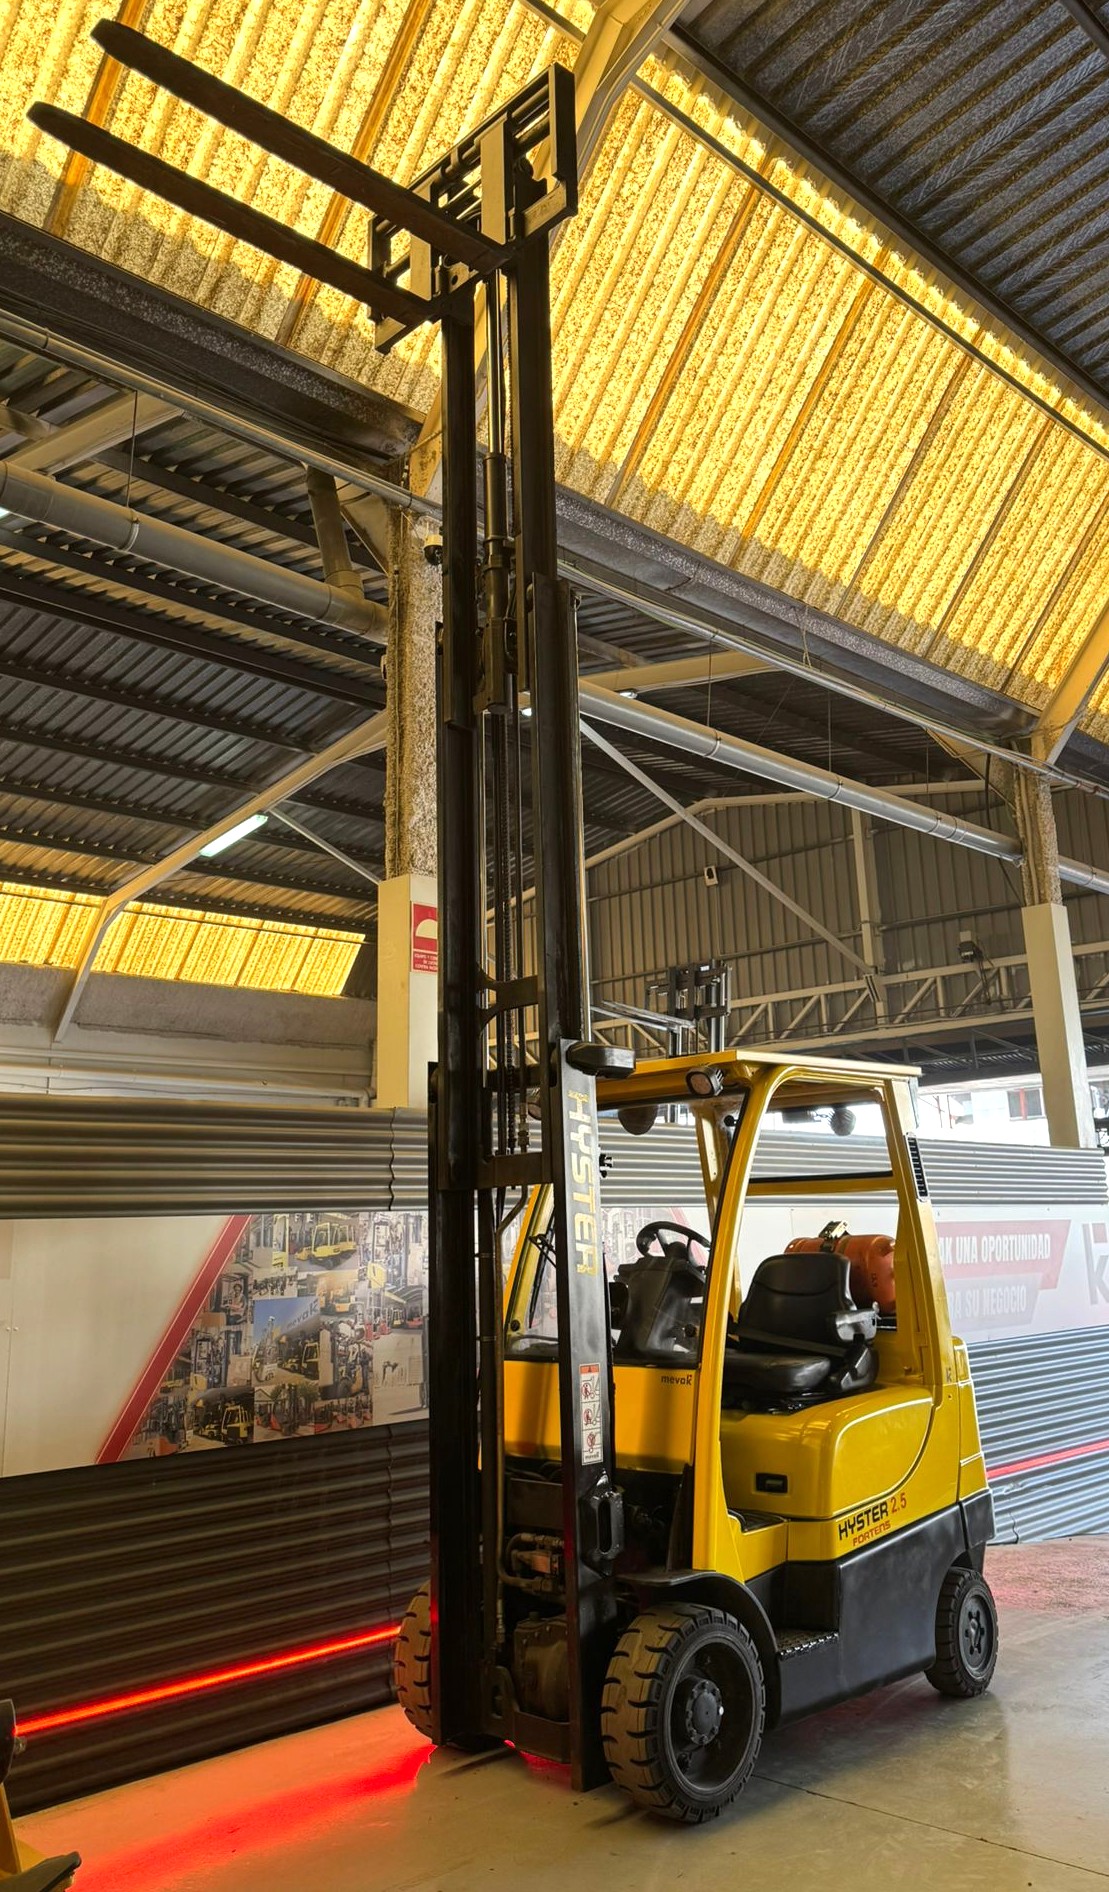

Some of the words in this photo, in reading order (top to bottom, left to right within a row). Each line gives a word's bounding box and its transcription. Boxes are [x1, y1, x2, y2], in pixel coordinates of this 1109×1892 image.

[567, 1090, 598, 1276] HYSTER
[956, 1236, 978, 1264] UNA
[981, 1233, 1051, 1262] OPORTUNIDAD
[964, 1288, 979, 1317] SU
[983, 1285, 1027, 1316] NEGOCIO
[661, 1374, 692, 1385] mevak
[838, 1501, 888, 1540] HYSTER
[890, 1492, 907, 1514] 2.5
[852, 1520, 891, 1546] FORTENS
